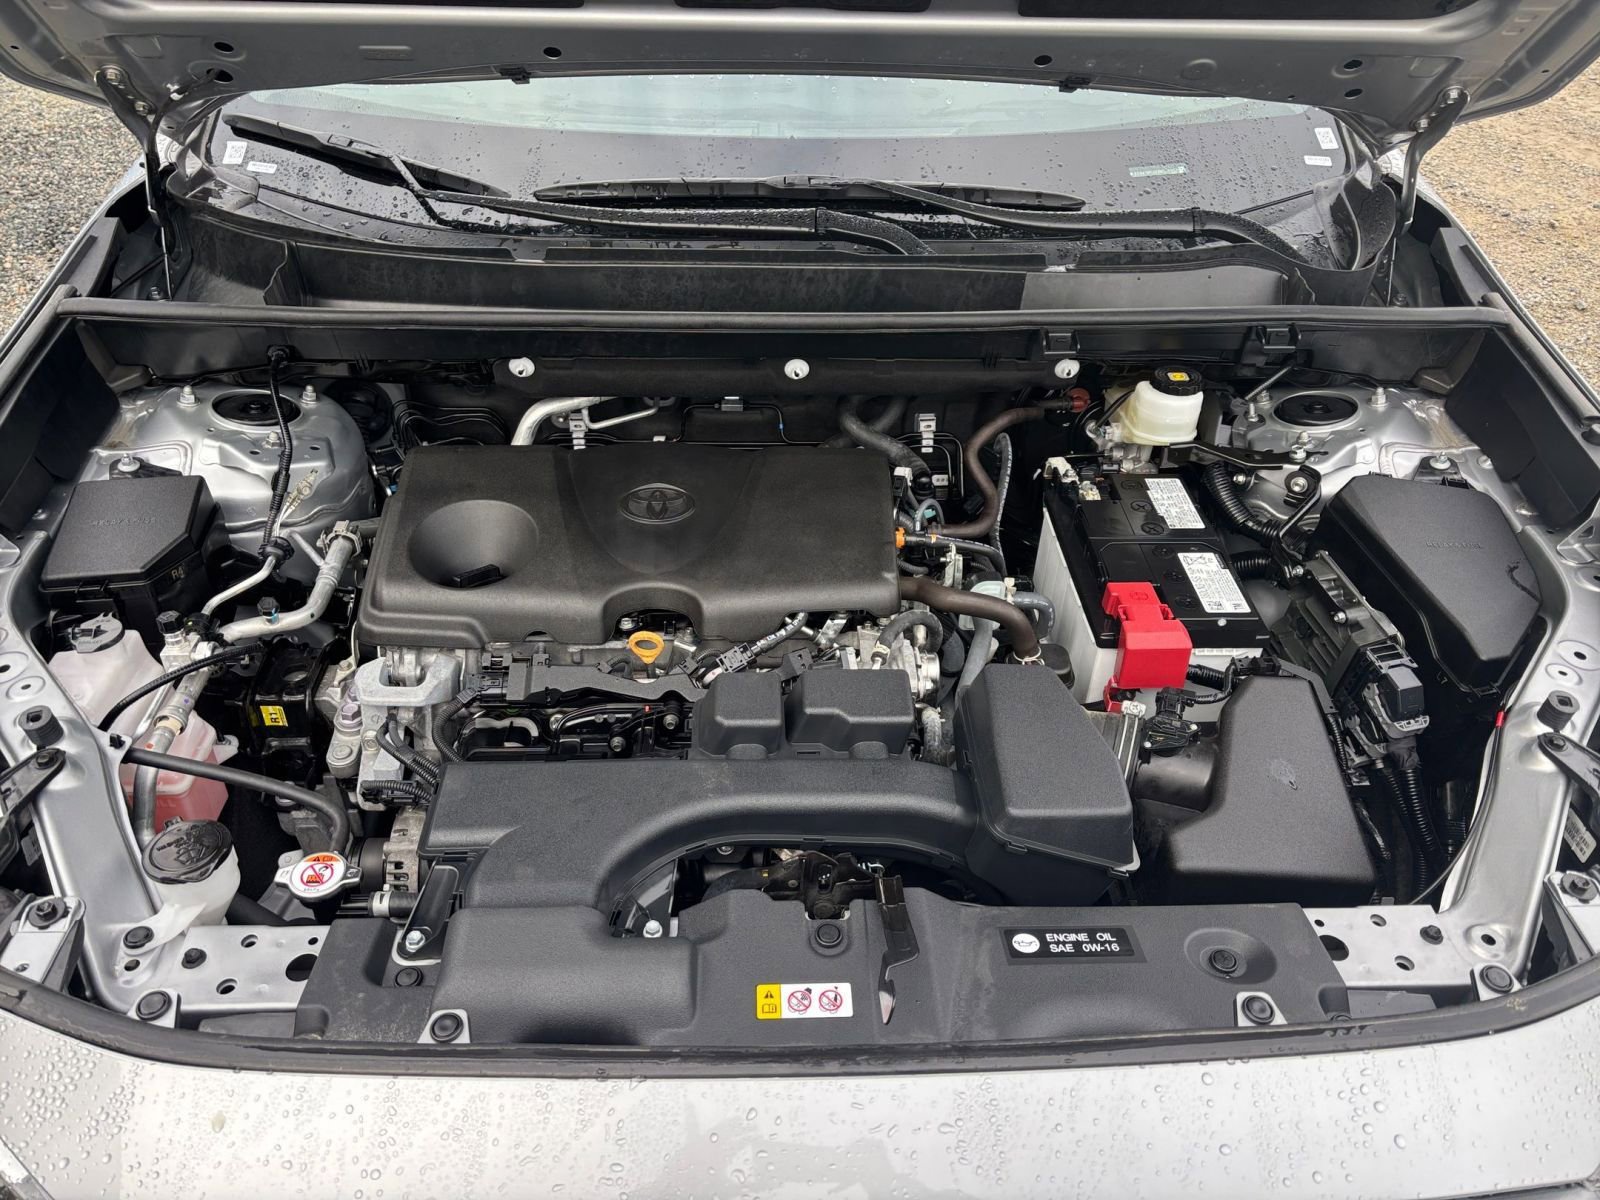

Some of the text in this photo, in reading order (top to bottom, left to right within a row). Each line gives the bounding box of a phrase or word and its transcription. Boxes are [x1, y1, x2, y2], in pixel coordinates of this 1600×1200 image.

[1045, 932, 1116, 942] ENGINE OIL
[1049, 943, 1120, 952] SAE 0W-16
